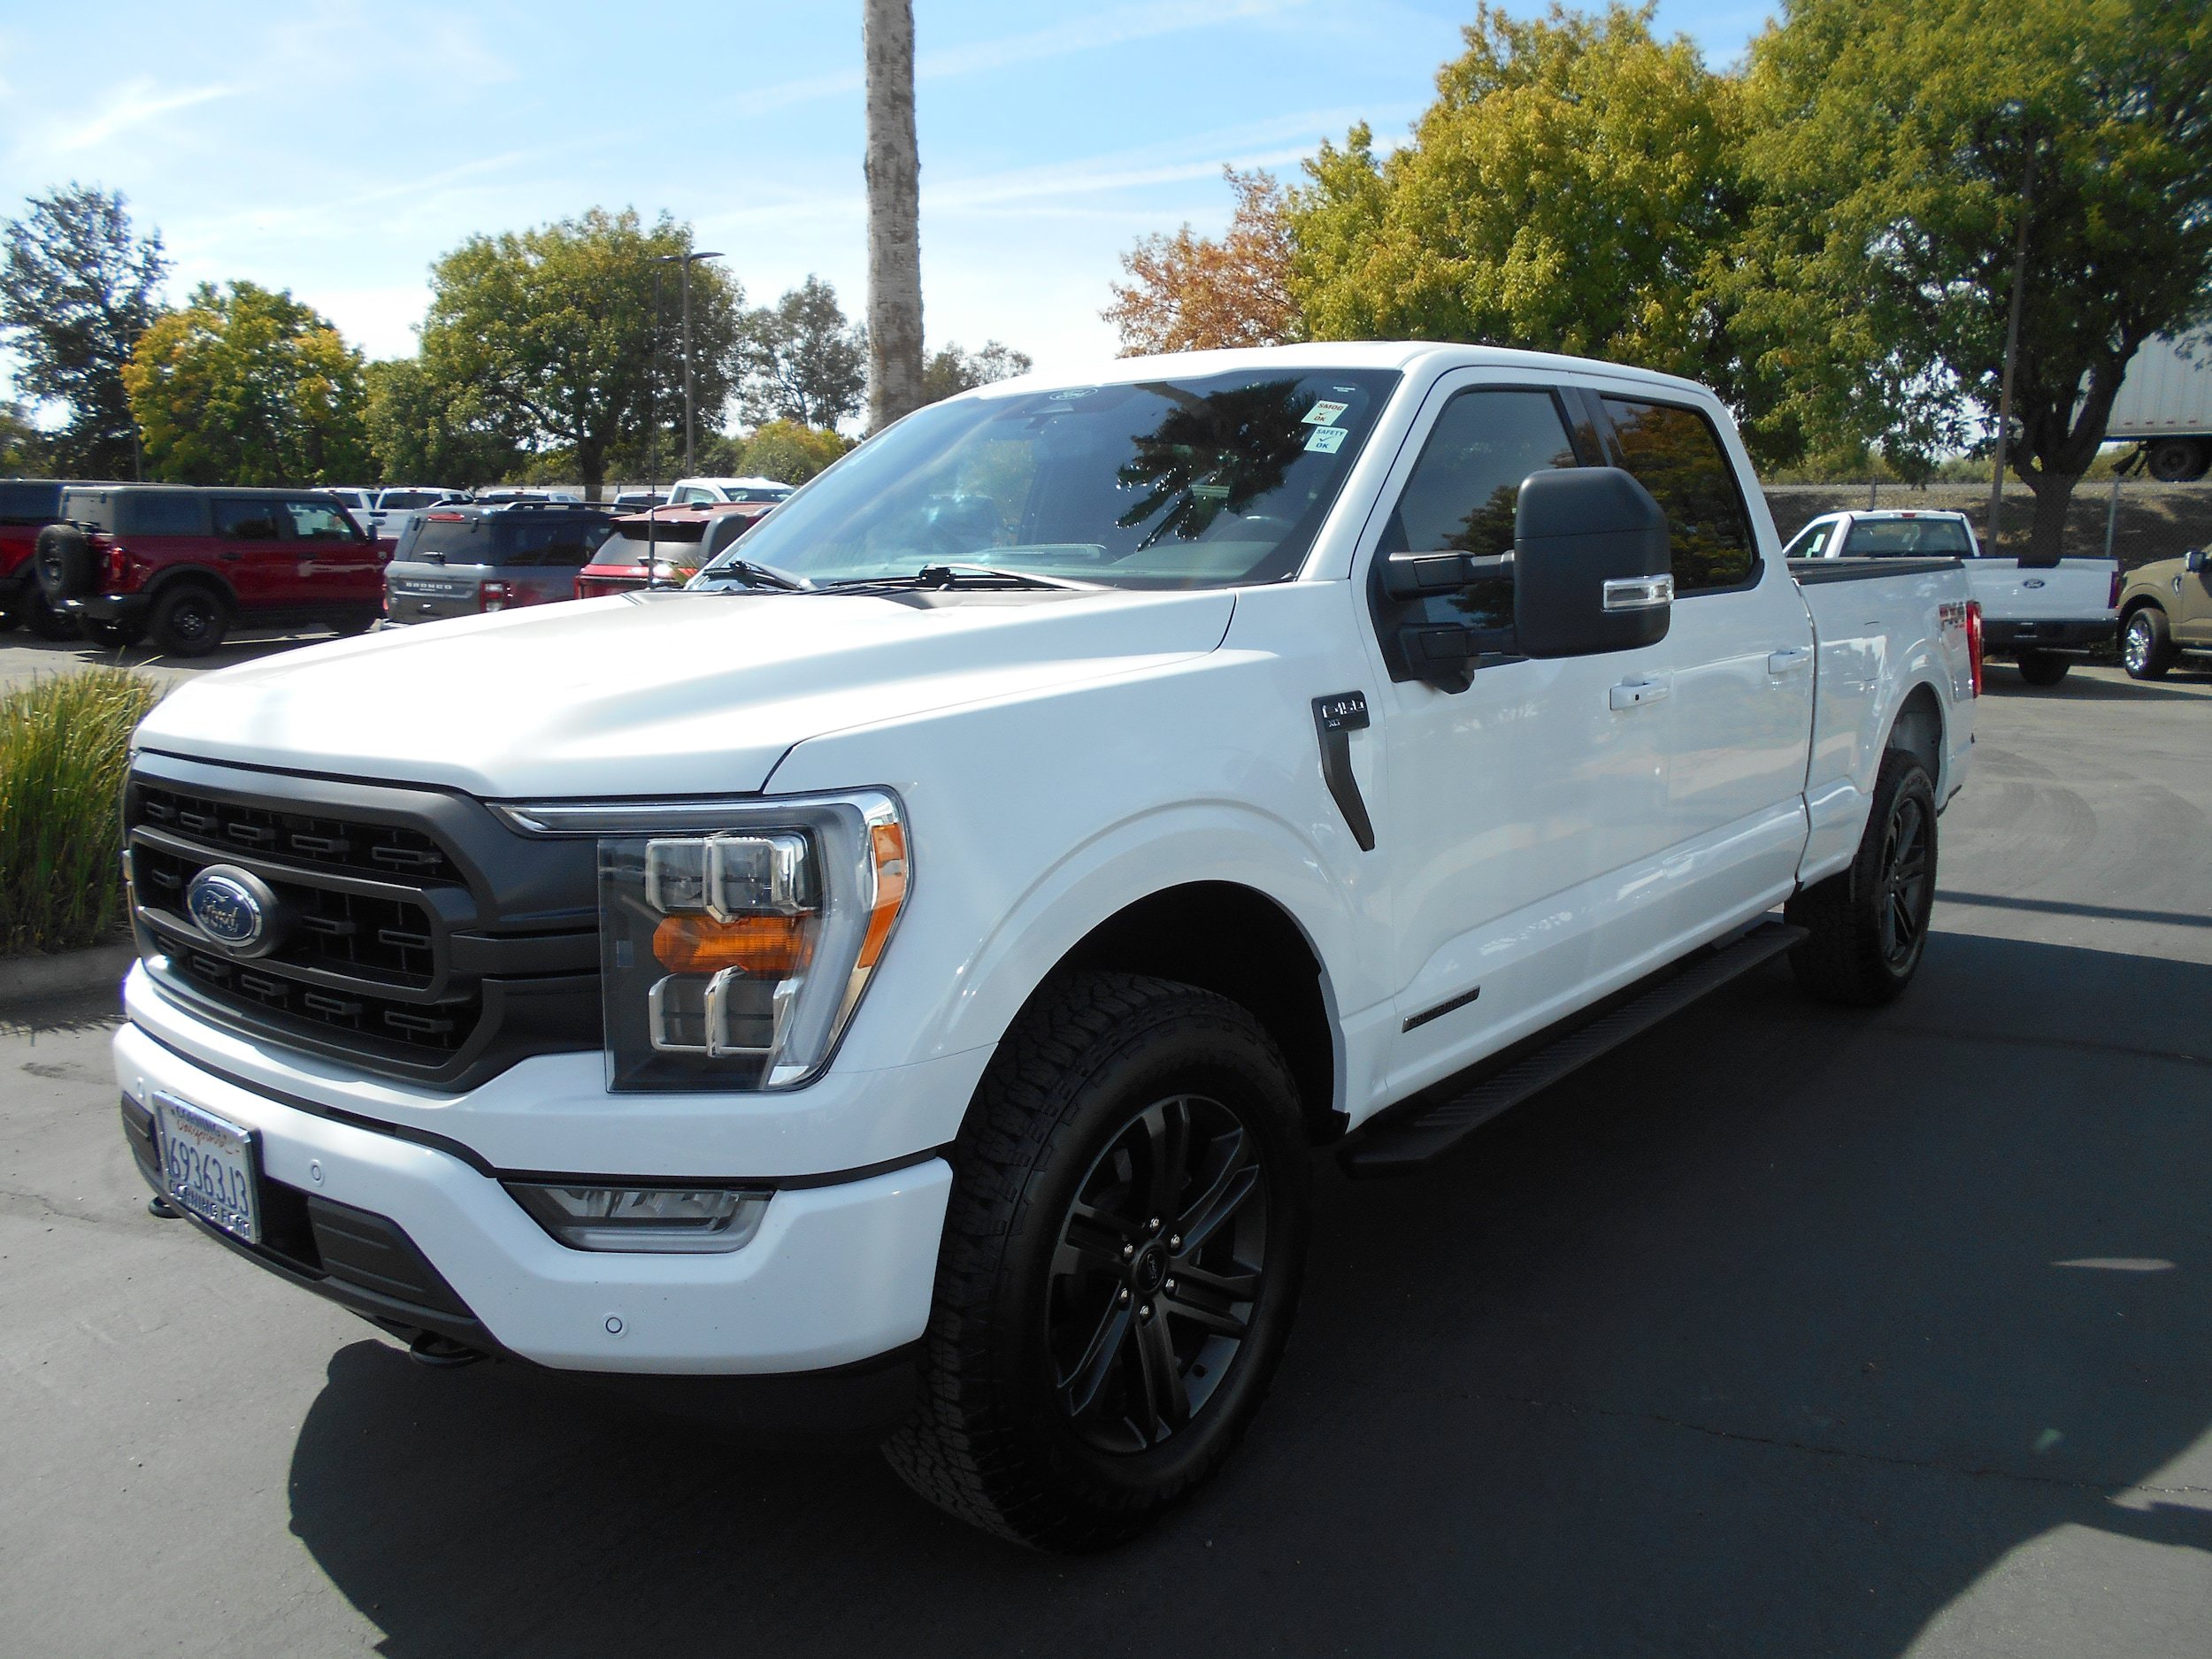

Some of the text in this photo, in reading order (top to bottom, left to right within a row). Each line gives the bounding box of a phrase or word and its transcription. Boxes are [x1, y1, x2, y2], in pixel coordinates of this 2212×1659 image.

[1317, 403, 1344, 411] SMOG
[199, 889, 239, 933] Ford
[170, 1137, 250, 1217] 69363J3
